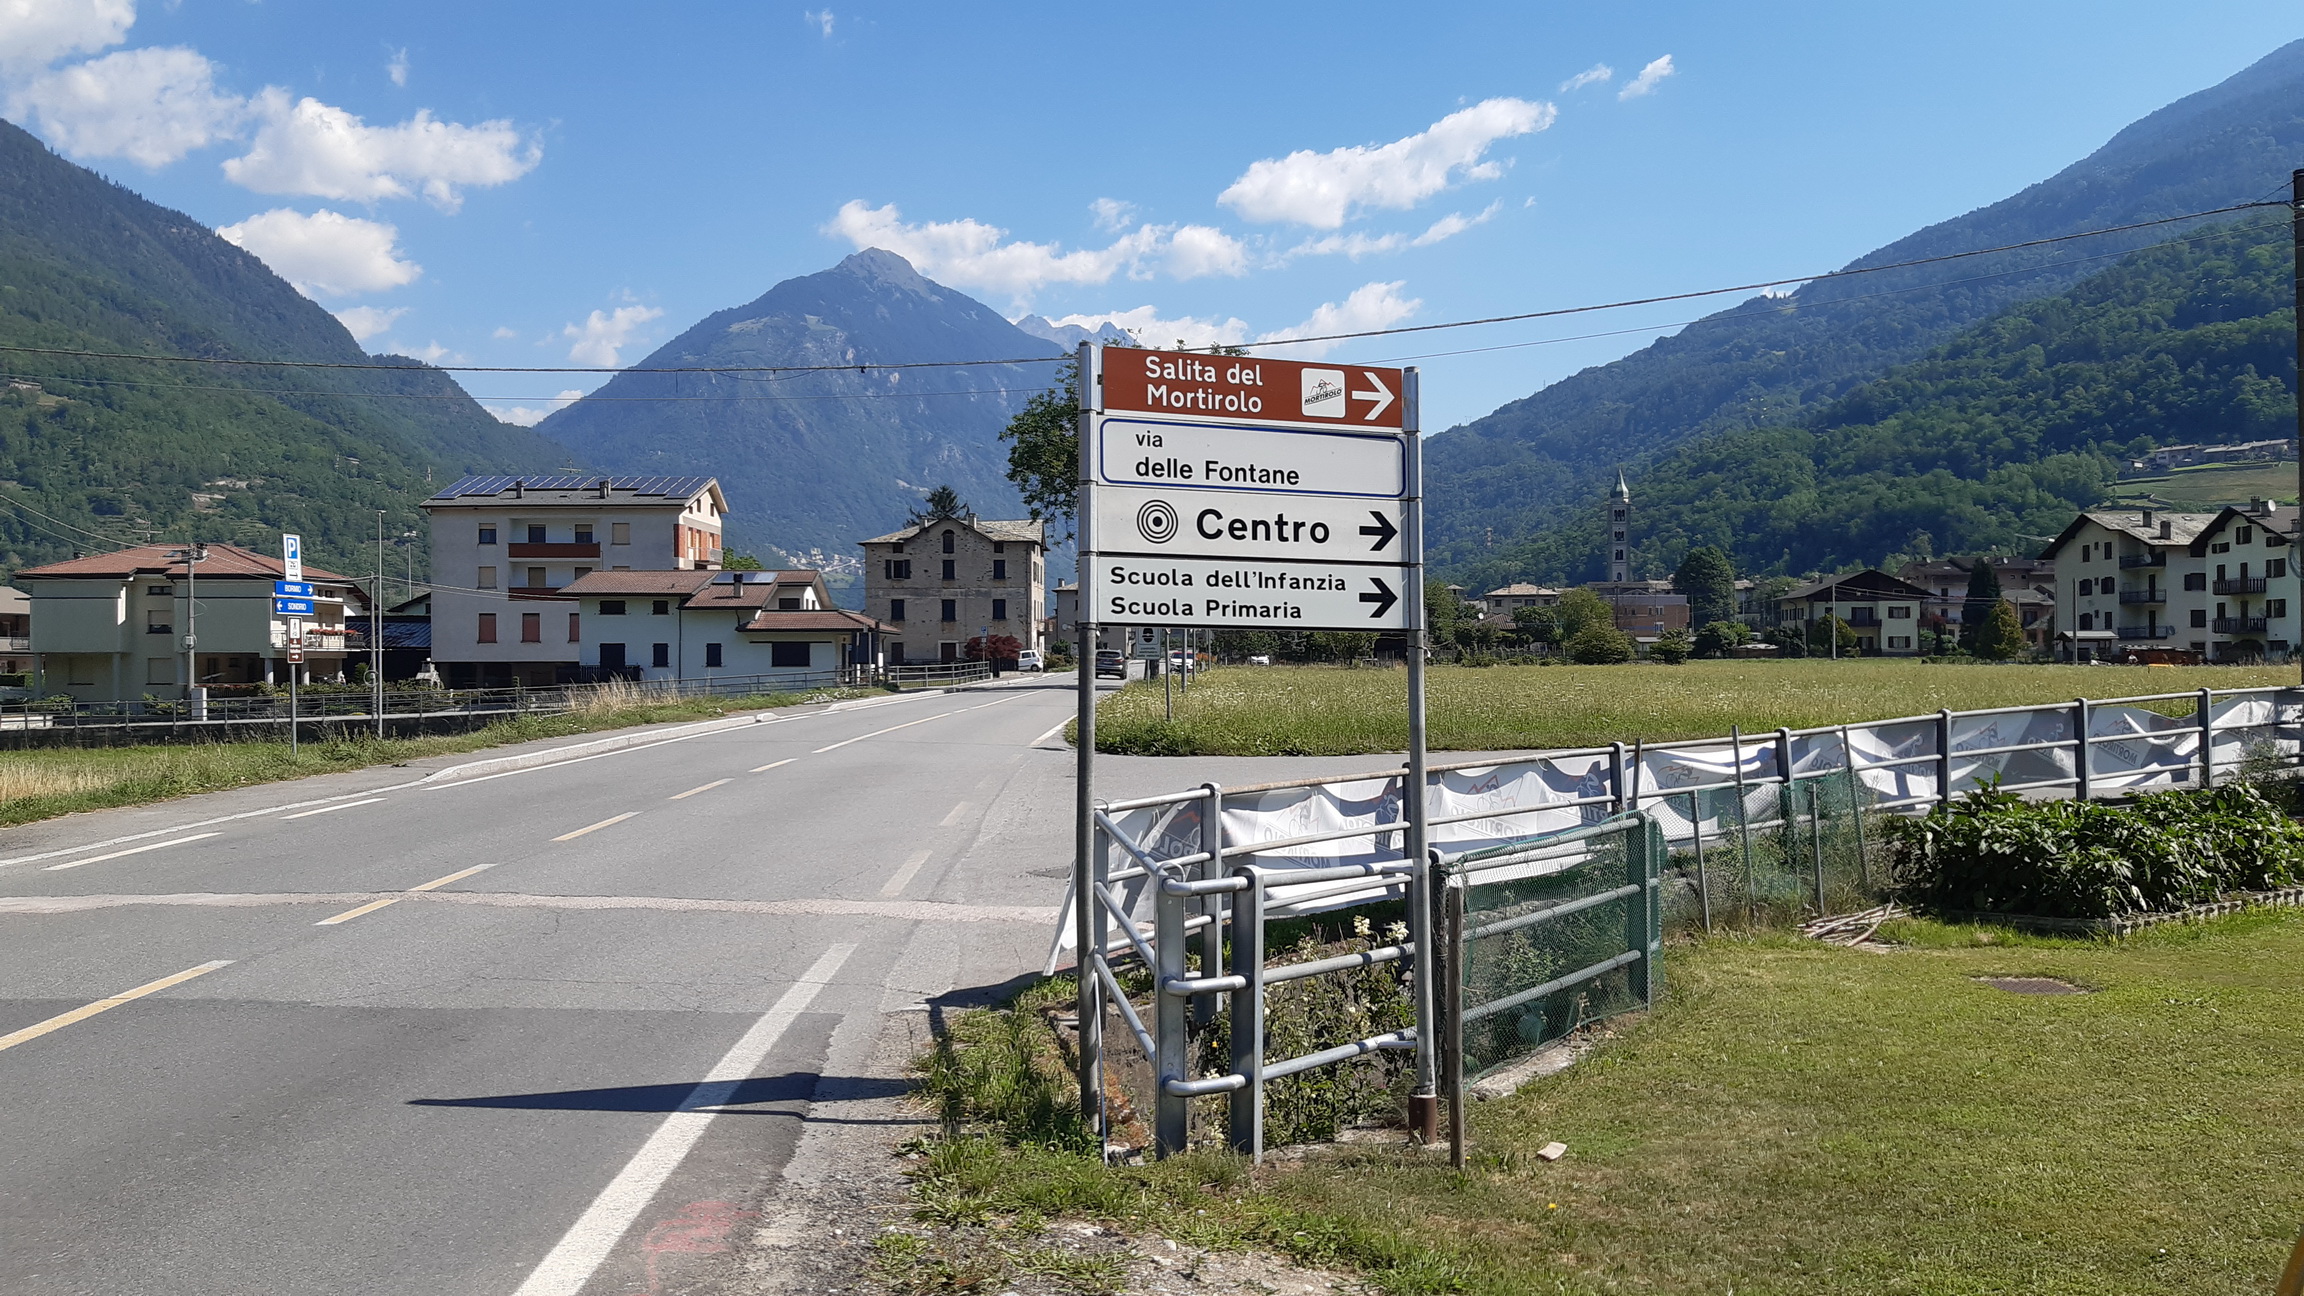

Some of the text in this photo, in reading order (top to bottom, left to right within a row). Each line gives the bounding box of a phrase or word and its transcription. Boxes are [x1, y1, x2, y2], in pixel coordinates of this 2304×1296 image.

[1145, 356, 1264, 386] Salita del
[1147, 384, 1263, 413] Mortirolo
[1304, 389, 1342, 405] MORTIROLO
[1135, 430, 1163, 448] via
[1135, 456, 1300, 485] delle Fontane
[1196, 508, 1330, 544] Centro
[287, 538, 296, 558] P
[284, 584, 302, 593] BORMIO
[1110, 566, 1347, 591] Scuola dell'Infanzia
[1110, 596, 1302, 619] Scuola Primaria
